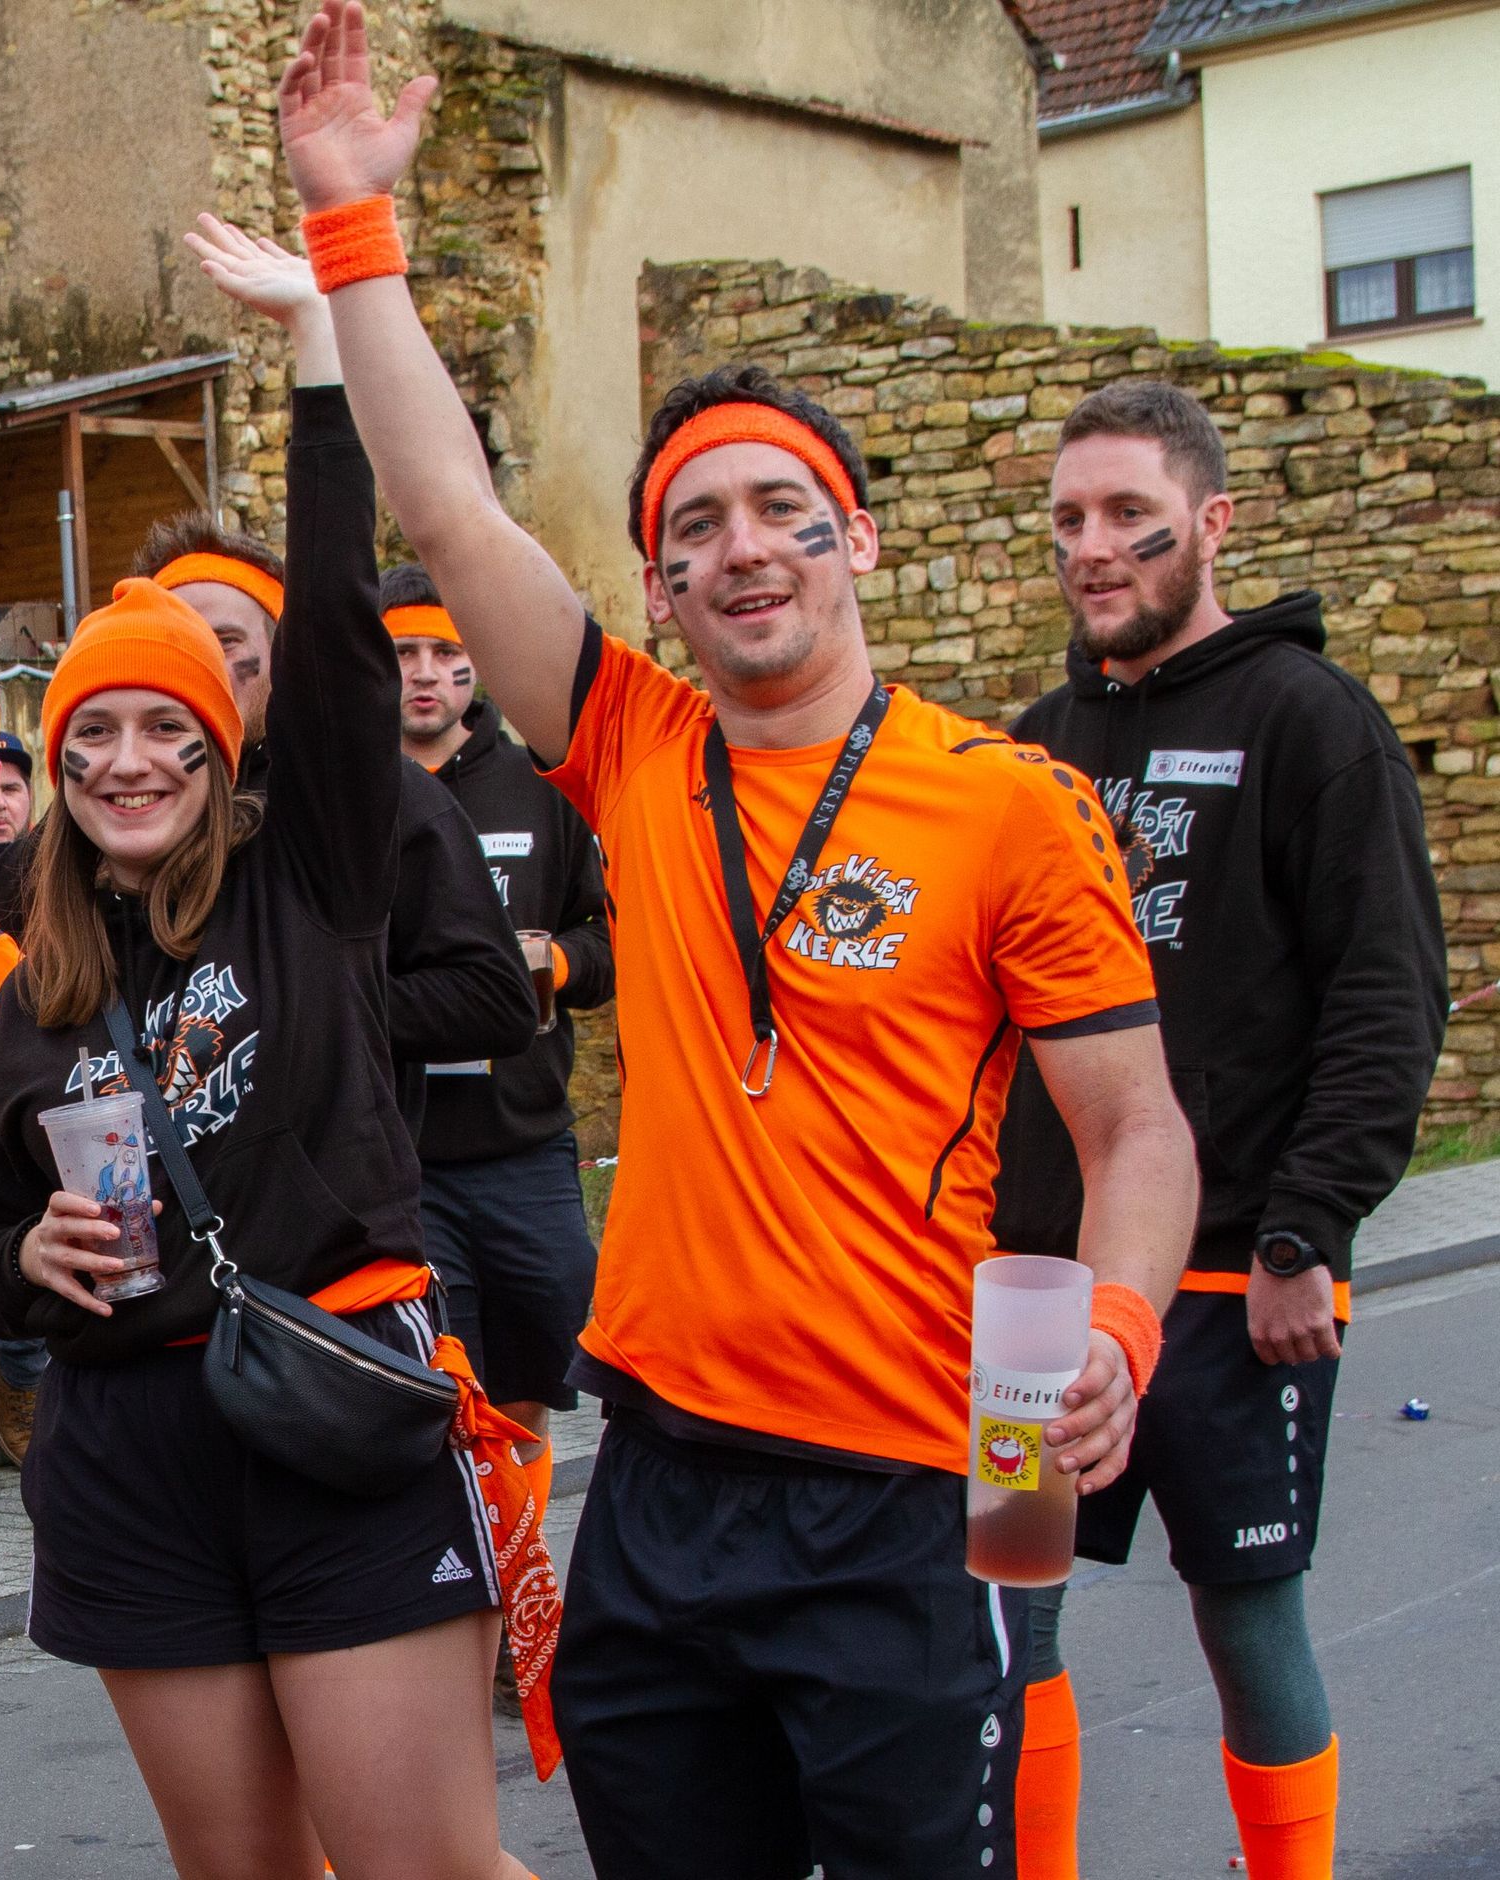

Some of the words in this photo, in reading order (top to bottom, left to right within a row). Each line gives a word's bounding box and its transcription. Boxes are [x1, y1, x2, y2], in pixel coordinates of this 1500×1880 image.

[1178, 760, 1240, 775] Eifelviez
[813, 753, 859, 828] FICKEN
[786, 918, 908, 970] KERLE
[993, 1383, 1061, 1404] Eifelvi
[980, 1424, 1039, 1459] ATOMTITTEN?
[981, 1462, 992, 1477] JA
[993, 1468, 1033, 1486] BITTE!
[1233, 1522, 1288, 1549] JAKO
[431, 1567, 474, 1583] adidas
